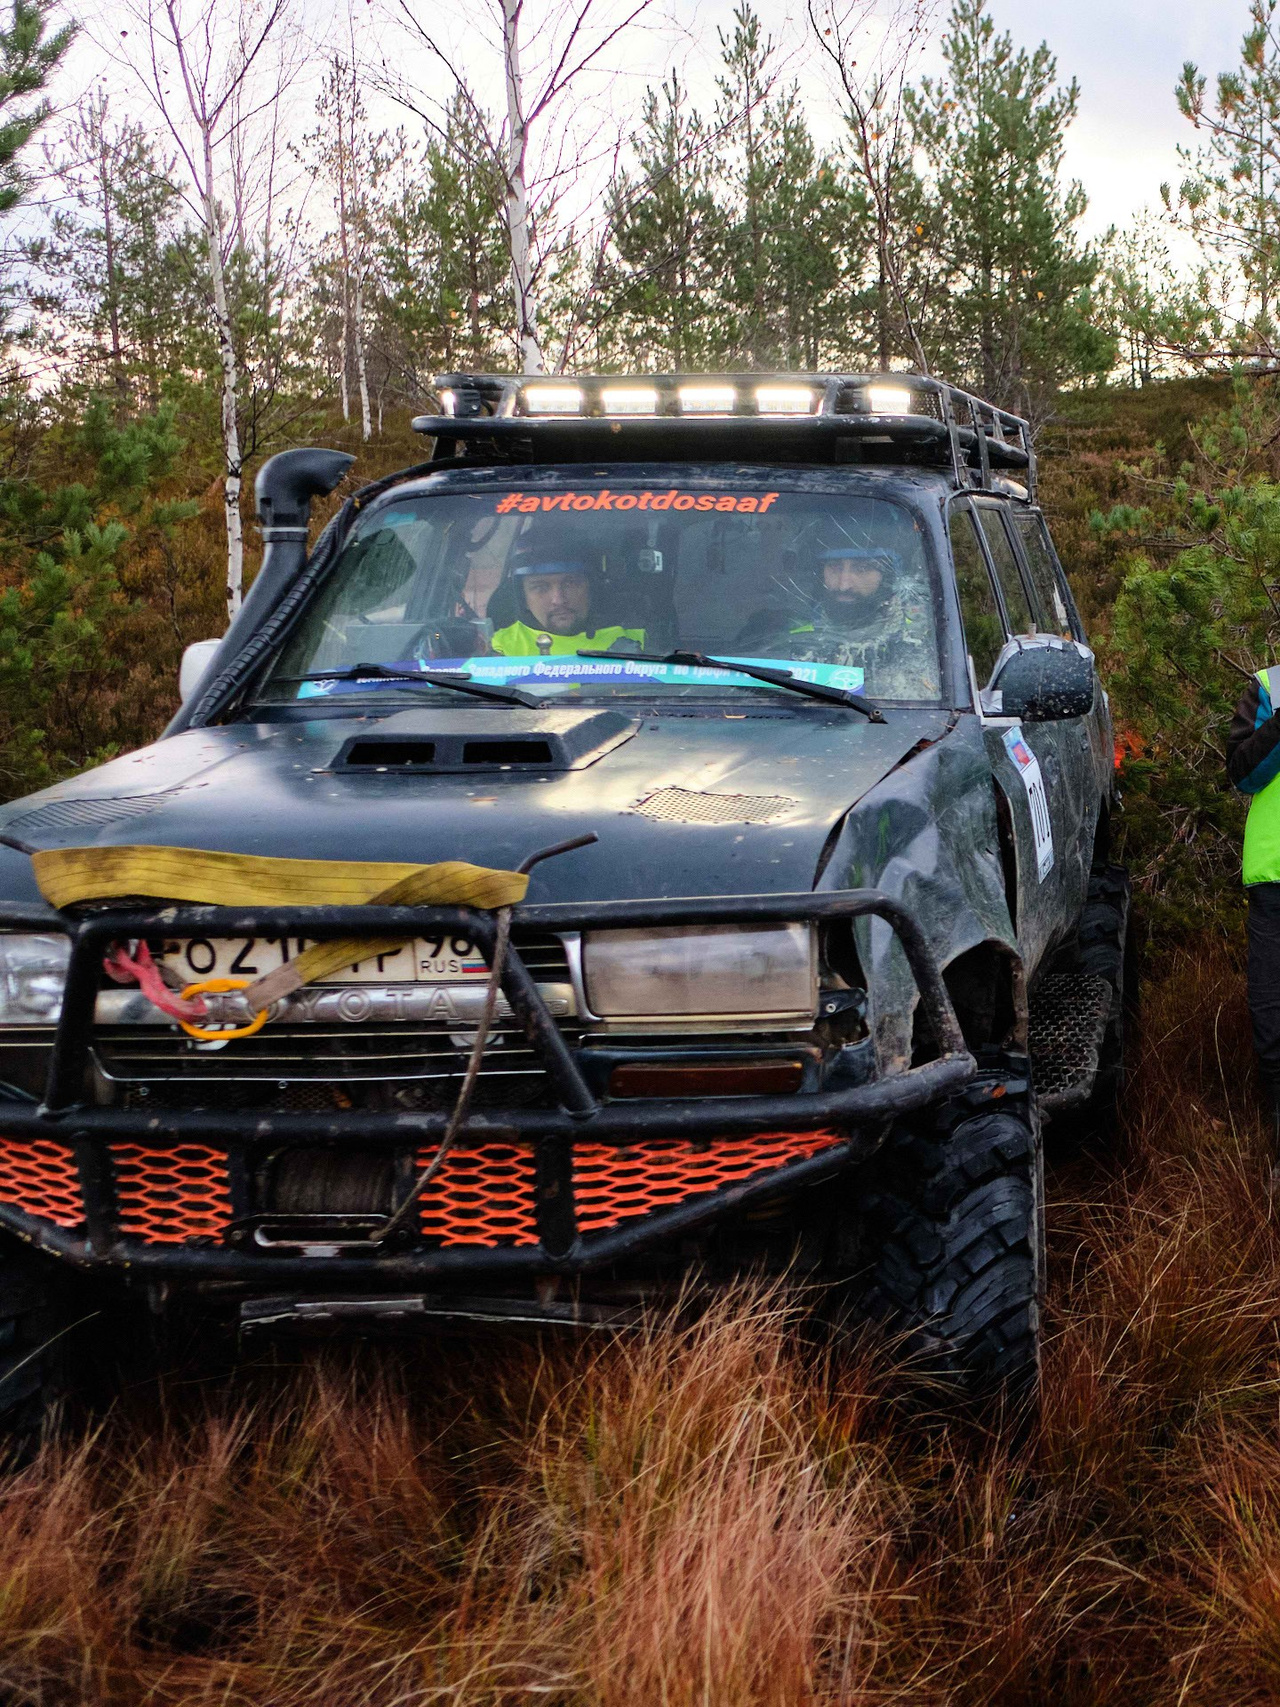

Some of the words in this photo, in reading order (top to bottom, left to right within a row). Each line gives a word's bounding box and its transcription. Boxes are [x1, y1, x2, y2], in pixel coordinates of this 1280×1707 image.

[496, 490, 779, 513] #avtokotdosaaf
[533, 660, 622, 678] Федерального
[624, 660, 668, 678] Округа
[421, 960, 458, 973] RUS
